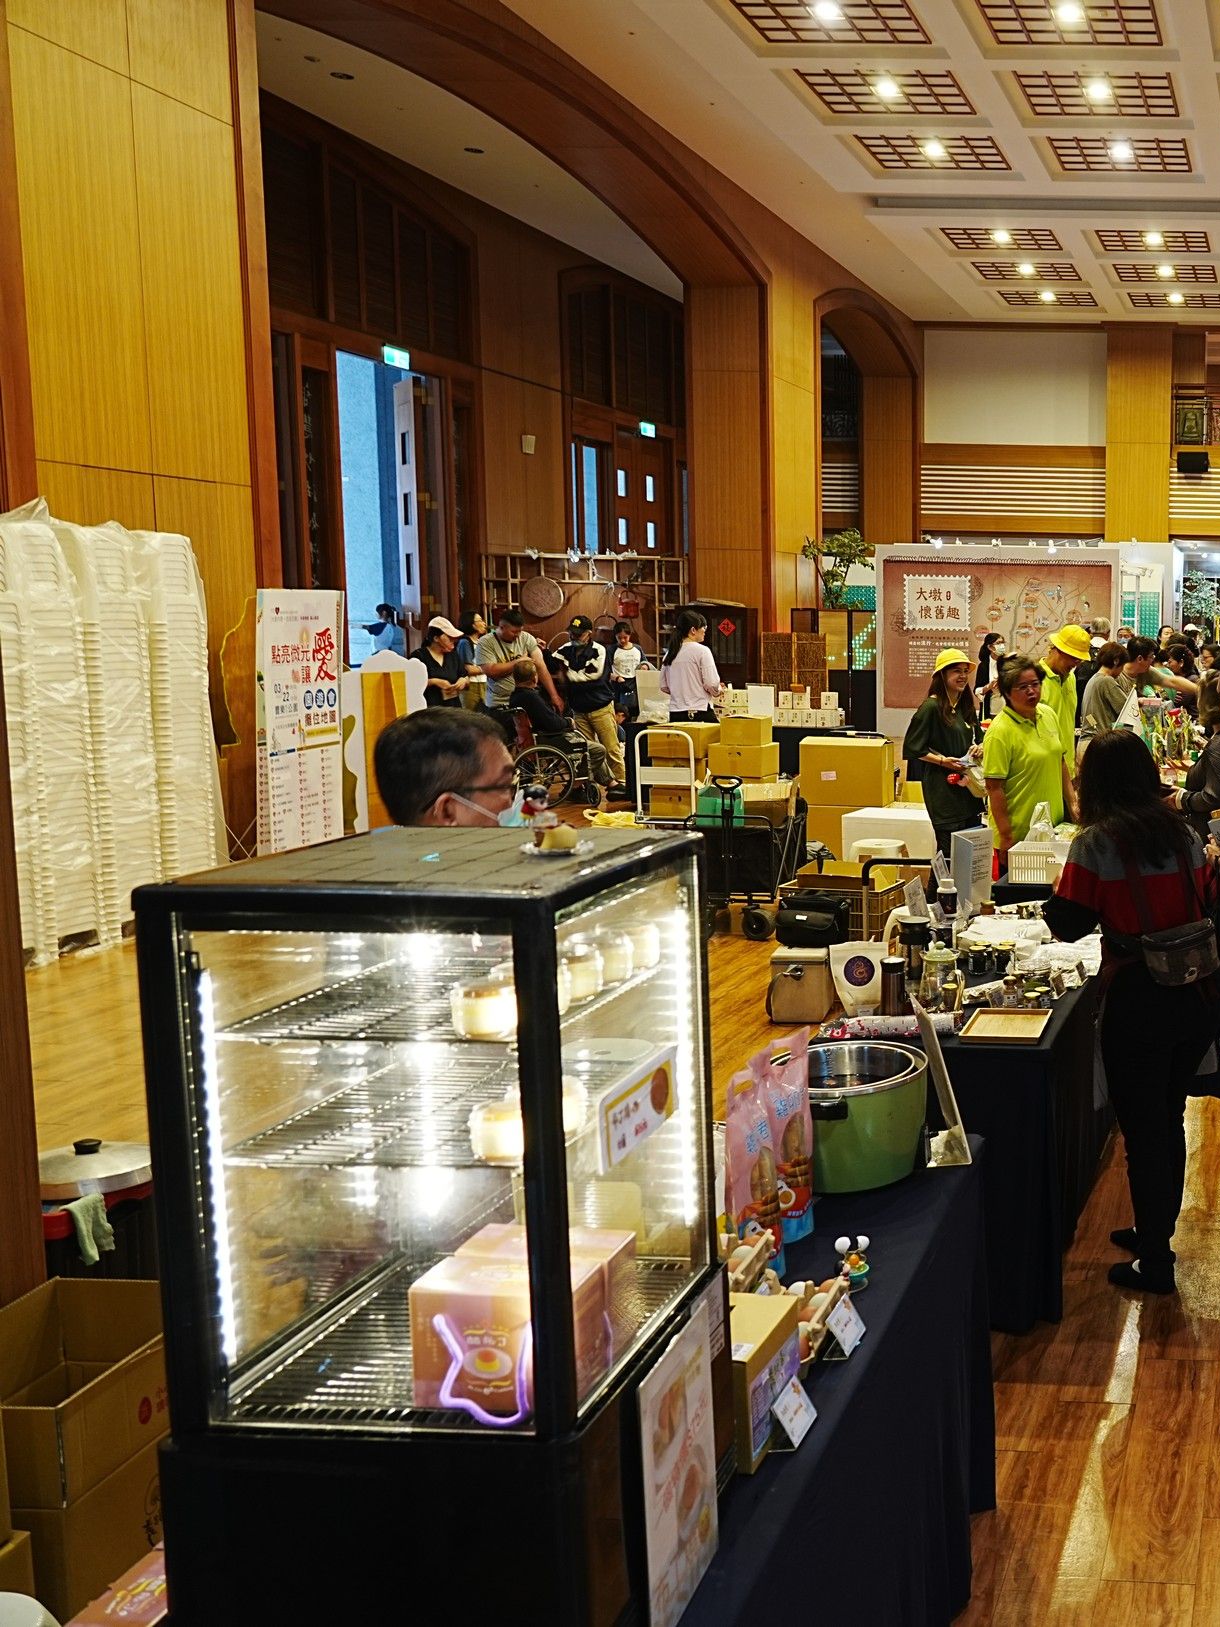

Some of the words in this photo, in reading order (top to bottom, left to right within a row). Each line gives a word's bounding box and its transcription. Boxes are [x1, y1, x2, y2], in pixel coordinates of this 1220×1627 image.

[916, 587, 943, 602] 大墩
[918, 605, 960, 620] 懷舊趣
